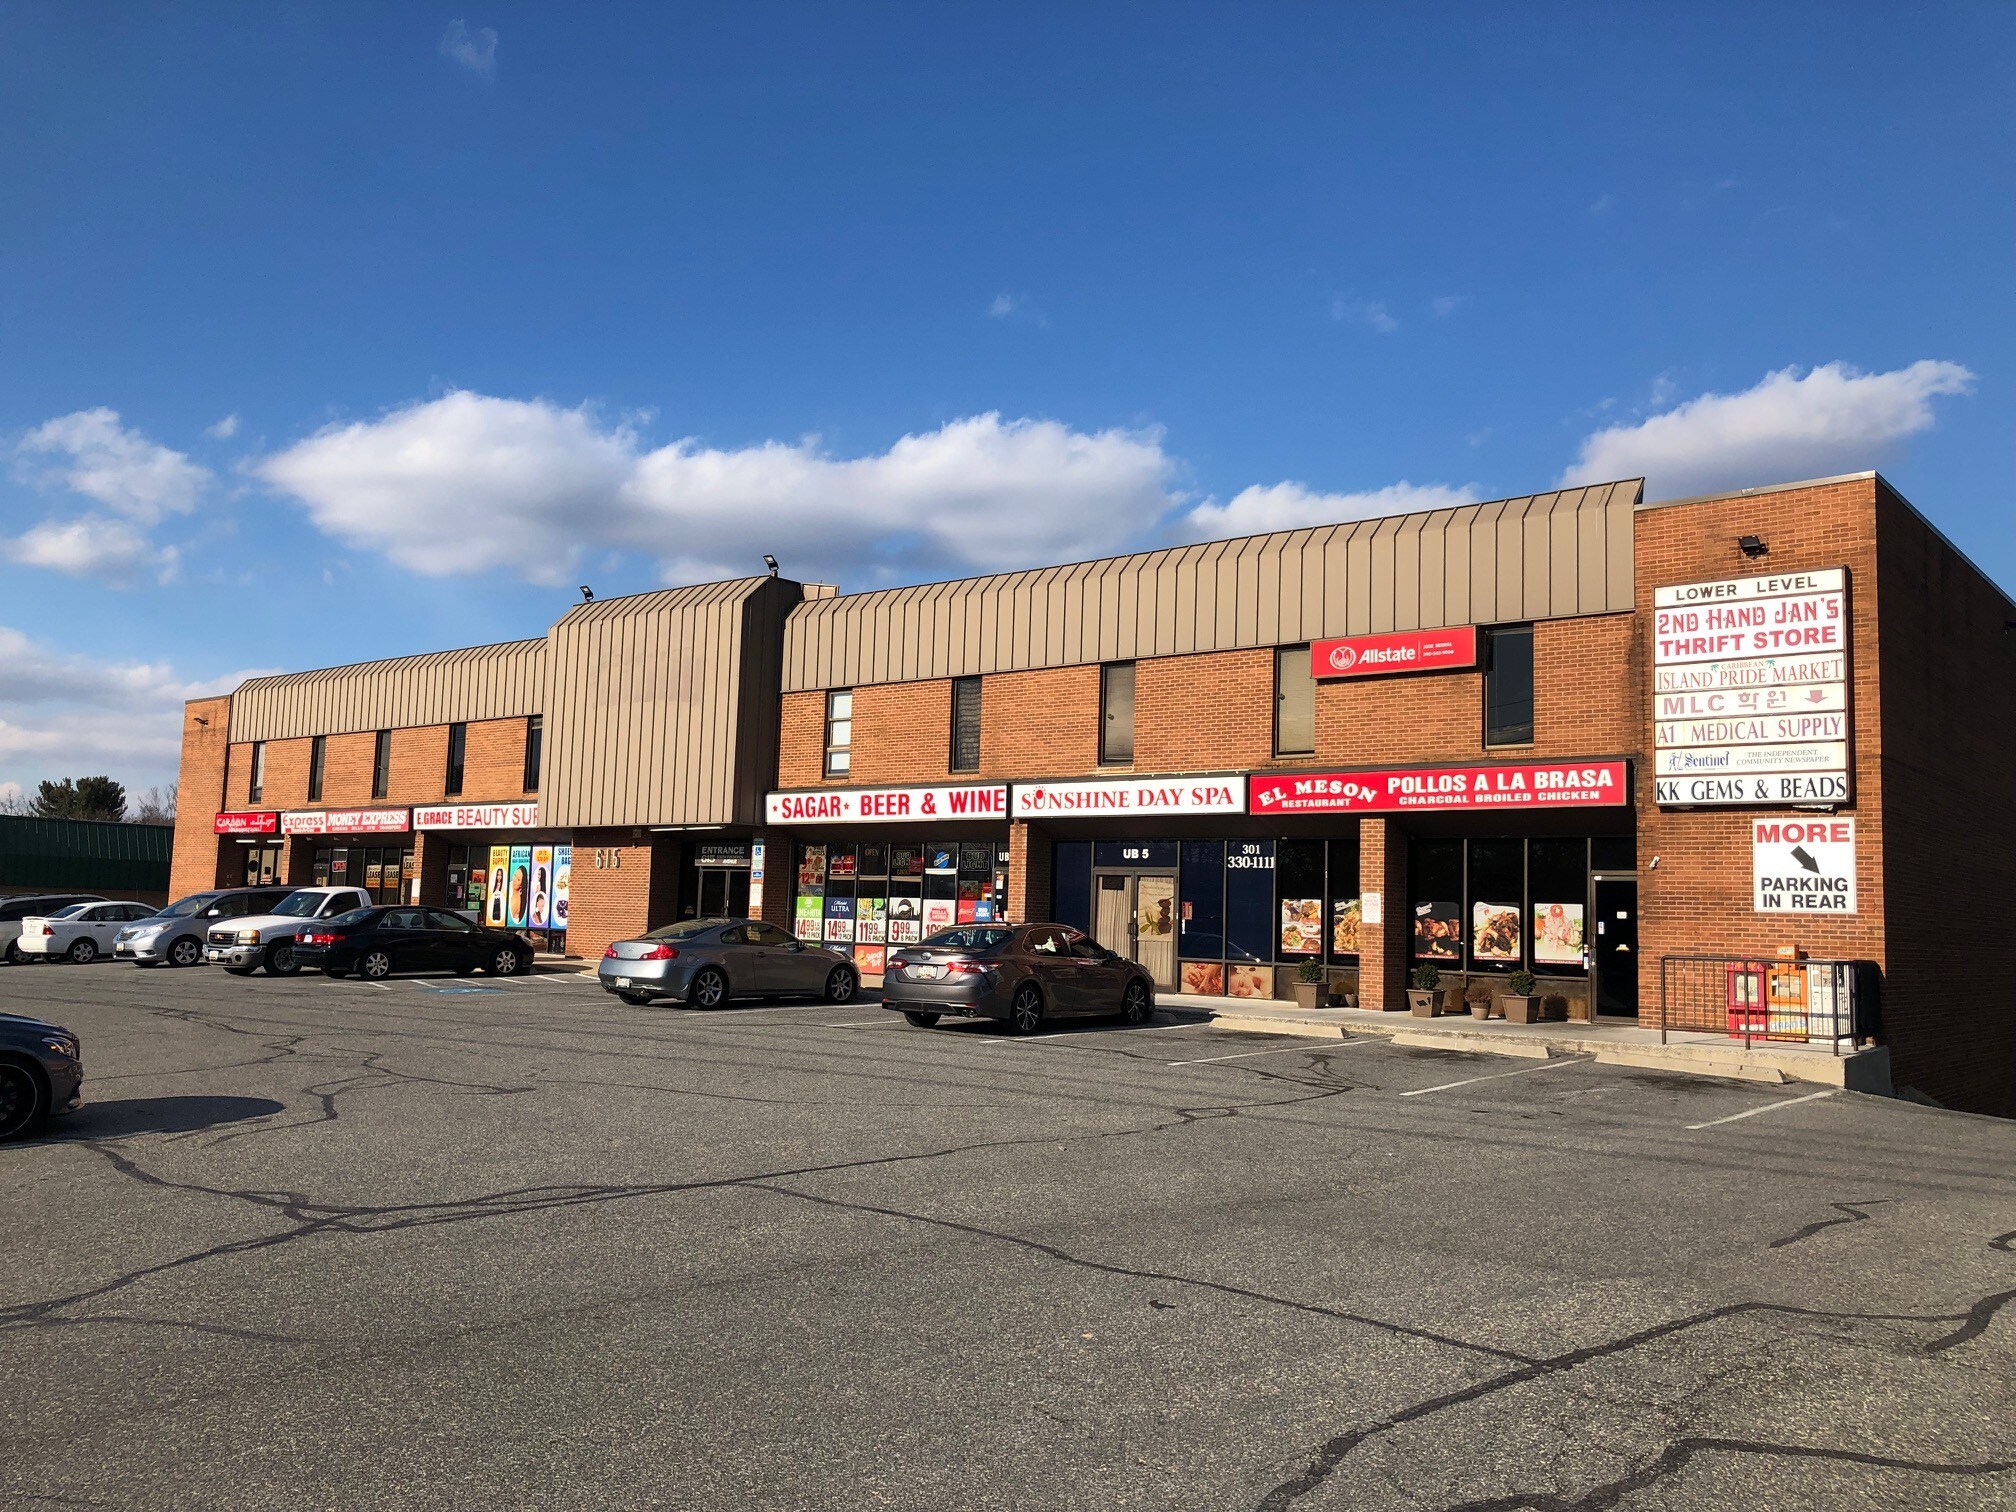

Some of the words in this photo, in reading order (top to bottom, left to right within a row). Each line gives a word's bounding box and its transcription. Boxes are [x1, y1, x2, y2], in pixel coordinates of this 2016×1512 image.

[1676, 584, 1737, 601] LOWER
[1757, 576, 1817, 593] LEVEL
[1658, 612, 1699, 635] 2ND
[1706, 606, 1765, 630] HAND
[1774, 597, 1839, 624] JAN'S
[1659, 633, 1745, 657] THRIFT
[1753, 626, 1836, 649] STORE
[1358, 646, 1416, 665] Allstate
[1721, 660, 1764, 669] CARIBBEAN
[1658, 671, 1713, 690] ISLAND
[1719, 667, 1767, 686] PRIDE
[1772, 658, 1842, 682] MARKET
[1663, 694, 1725, 715] MLC
[1738, 690, 1787, 711] 학원
[1657, 725, 1675, 744] A1
[1691, 720, 1769, 743] MEDICAL
[1778, 716, 1842, 738] SUPPLY
[1684, 750, 1730, 768] Sentinel
[1736, 757, 1783, 765] COMMUNITY
[1784, 755, 1829, 763] NEWSPAPER
[1763, 749, 1818, 757] INDEPENDENT
[1387, 774, 1467, 794] POLLOS
[1474, 773, 1489, 791] A
[1497, 772, 1526, 790] LA
[1534, 769, 1613, 789] BRASA
[1656, 781, 1681, 802] KK
[1690, 779, 1744, 800] GEMS
[1754, 779, 1769, 799] &
[1780, 776, 1846, 798] BEADS
[1021, 788, 1130, 810] SUNSHINE
[1137, 788, 1184, 807] DAY
[1191, 787, 1234, 806] SPA
[1258, 787, 1287, 807] EL
[1294, 779, 1377, 803] MESON
[1398, 795, 1469, 805] CHARCOAL
[1475, 792, 1532, 802] BROILED
[1538, 790, 1600, 801] CHICKEN
[782, 795, 841, 819] SAGAR
[860, 793, 909, 816] BEER
[921, 792, 936, 814] &
[949, 789, 1005, 814] WINE
[1281, 798, 1352, 808] RESTAURANT
[283, 815, 324, 830] Express
[327, 811, 362, 826] MONEY
[361, 810, 407, 825] EXPRESS
[417, 811, 452, 825] E.GRACE
[457, 808, 509, 826] BEAUTY
[1756, 823, 1850, 843] MORE
[493, 849, 508, 857] BEAUTY
[701, 846, 745, 854] ENTRANCE
[864, 848, 880, 856] OPEN
[966, 852, 984, 860] BUD
[1123, 849, 1139, 859] UB
[1141, 849, 1149, 859] 5
[1242, 844, 1260, 854] 301
[595, 848, 621, 869] 615
[962, 861, 987, 870] LIGHT
[1227, 856, 1275, 869] 330-1111
[1761, 877, 1848, 892] PARKING
[1763, 893, 1781, 908] IN
[1791, 894, 1846, 909] REAR
